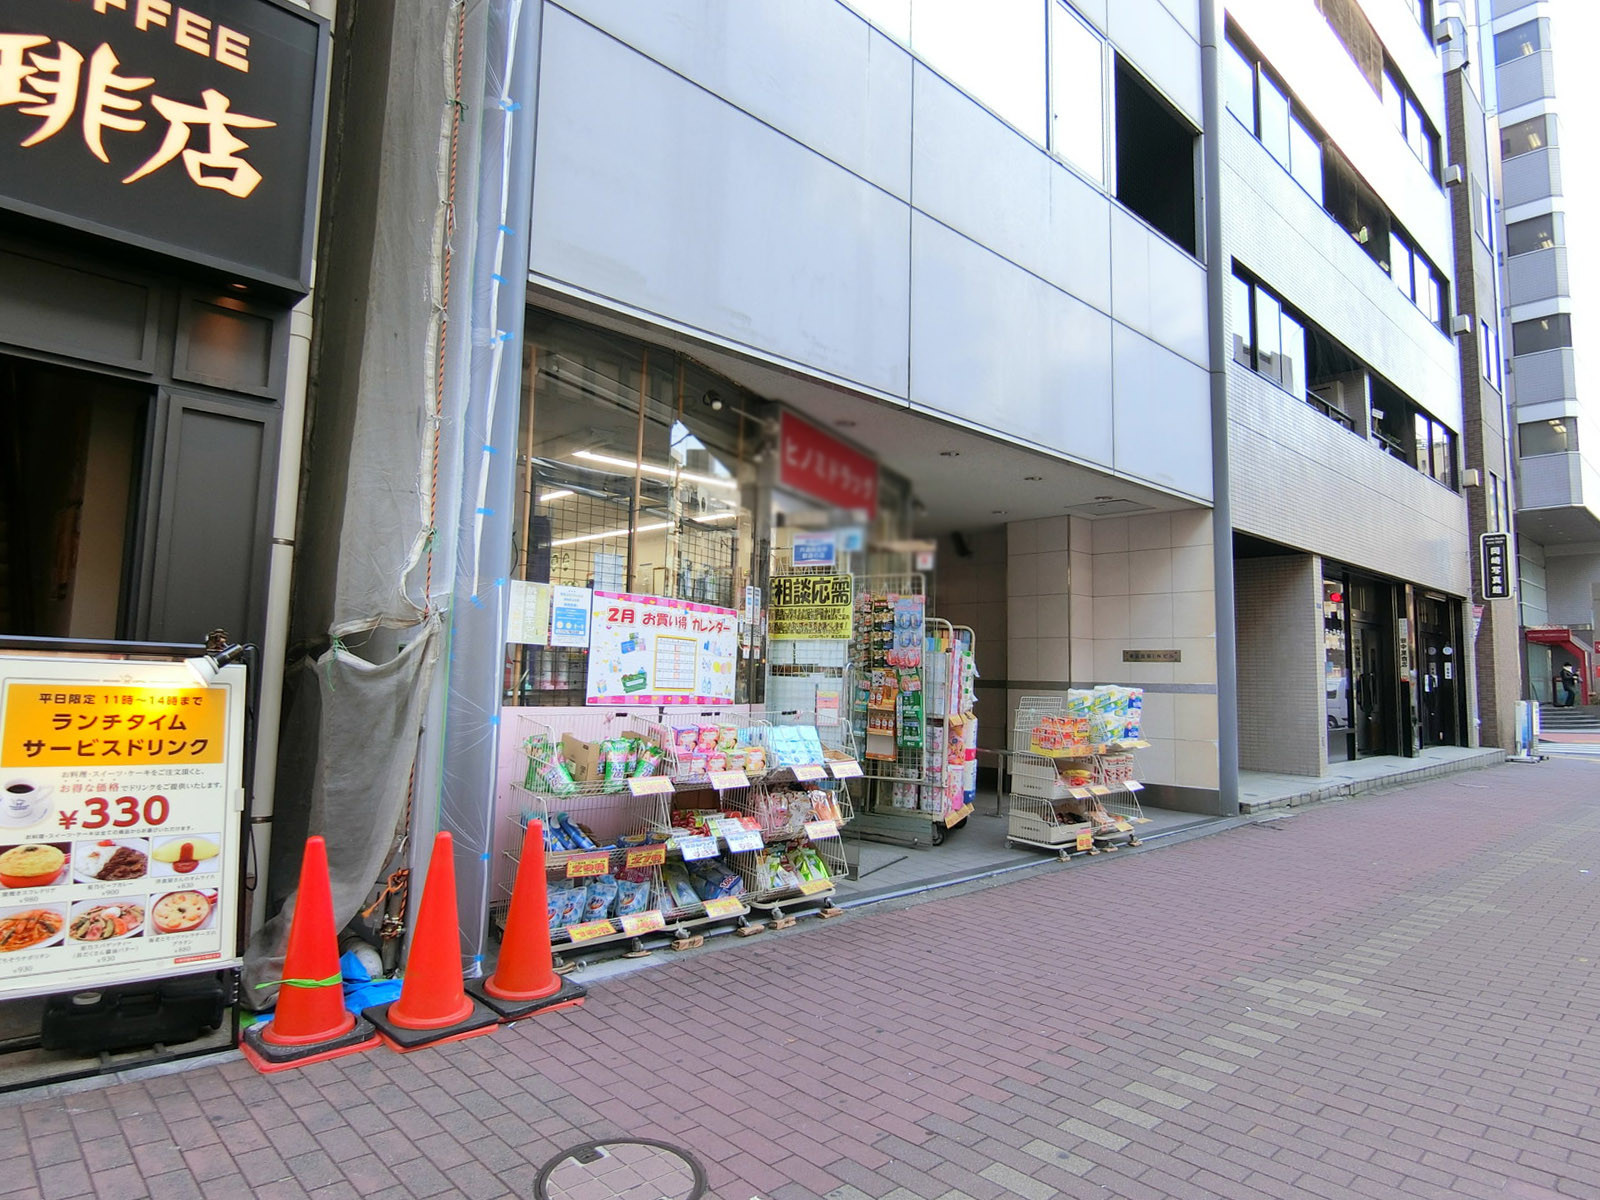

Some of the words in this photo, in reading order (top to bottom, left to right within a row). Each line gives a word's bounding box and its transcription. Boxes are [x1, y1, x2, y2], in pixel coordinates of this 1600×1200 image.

[607, 607, 636, 625] 2月
[642, 611, 688, 631] お買い得
[691, 618, 732, 634] カレンダー
[39, 693, 96, 705] 平日限定
[52, 713, 188, 731] ランチタイム
[23, 738, 209, 758] サービスドリンク
